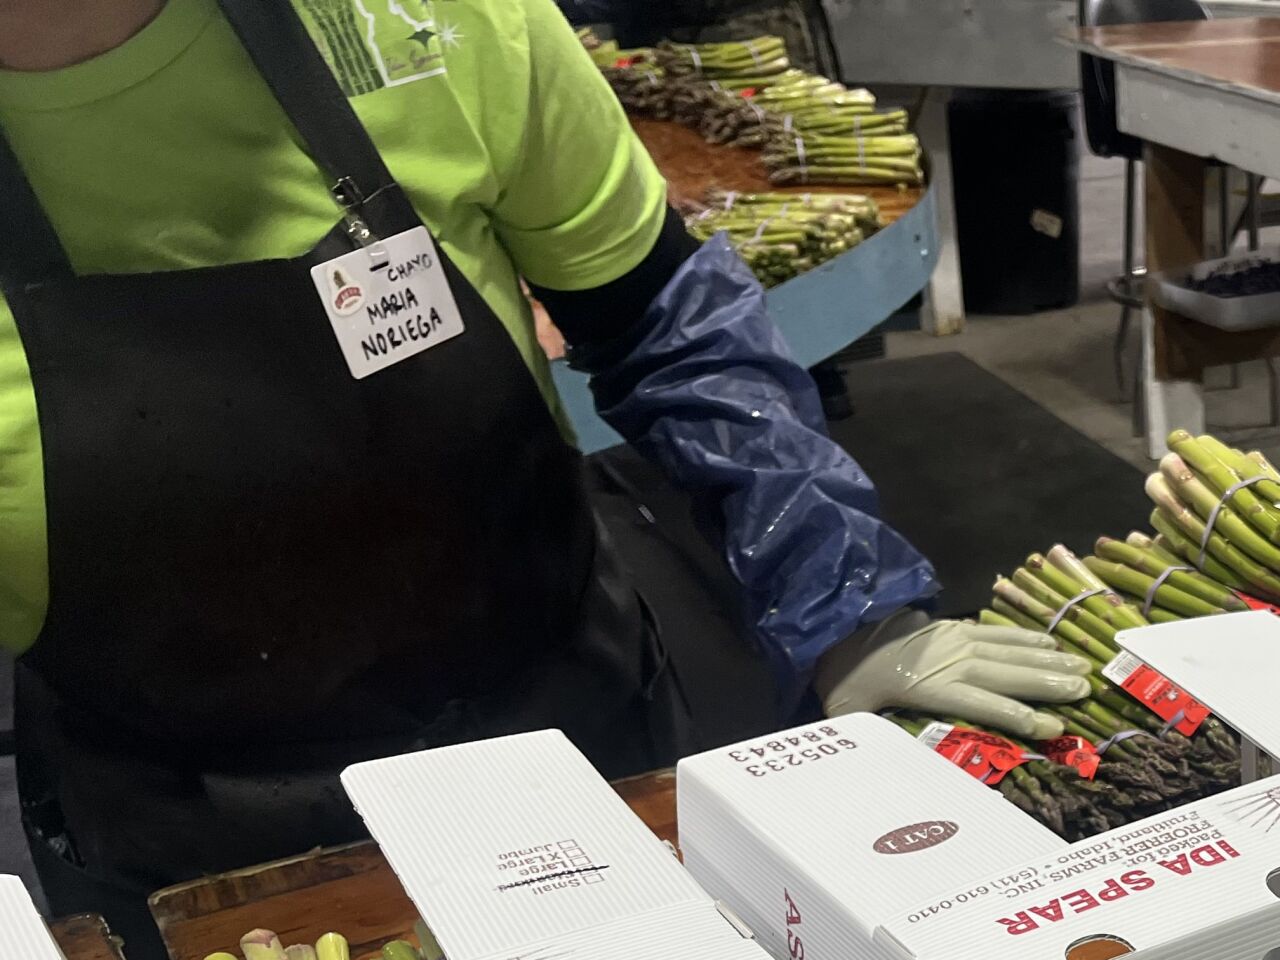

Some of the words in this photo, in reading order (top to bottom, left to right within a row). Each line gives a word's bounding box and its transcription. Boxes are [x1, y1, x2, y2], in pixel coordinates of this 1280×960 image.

[366, 287, 419, 325] MARIA
[361, 307, 442, 360] NORIEGA
[728, 726, 839, 763] 884843
[746, 738, 857, 778] 605233
[903, 825, 946, 846] CAT
[1111, 810, 1200, 845] Fruitland,
[1127, 819, 1216, 859] FROERER
[498, 843, 553, 860] Jumbo
[548, 851, 562, 861] X
[1057, 839, 1110, 865] Idaho
[1153, 829, 1225, 862] Packed
[1157, 838, 1241, 879] IDA
[497, 857, 546, 871] Large
[519, 860, 568, 877] Large
[991, 865, 1040, 890] (541)
[532, 877, 581, 895] Small
[906, 881, 990, 924] 610-0410
[995, 868, 1157, 936] SPEAR
